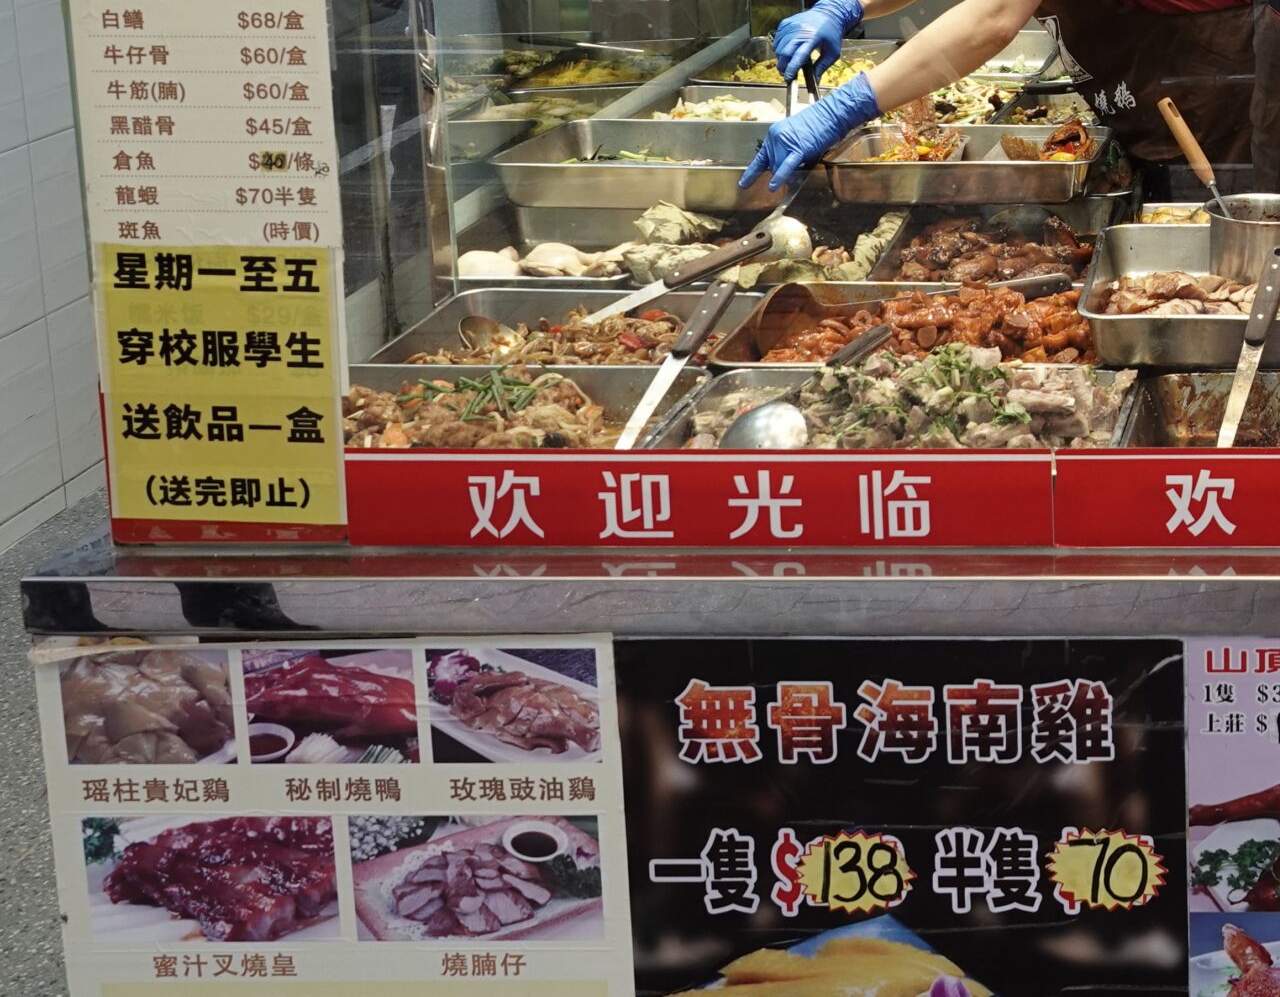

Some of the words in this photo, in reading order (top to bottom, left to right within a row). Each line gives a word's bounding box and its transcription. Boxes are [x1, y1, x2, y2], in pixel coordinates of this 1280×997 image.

[237, 10, 305, 31] $68/盒
[103, 45, 170, 66] 牛仔骨
[240, 45, 307, 66] $60/盒
[107, 80, 186, 103] 牛筋(腩)
[243, 81, 310, 101] $60/盒
[110, 115, 175, 136] 黑醋骨
[246, 116, 312, 137] $45/盒
[112, 150, 156, 171] 倉魚
[115, 185, 159, 205] 龍蝦
[235, 186, 317, 206] $70半隻
[118, 220, 161, 240] 斑魚
[263, 221, 320, 242] (時價)
[113, 251, 320, 293] 星期一至五
[117, 328, 324, 369] 穿校服學生
[122, 403, 325, 444] 送飲品一盒
[146, 475, 310, 509] (送完即止)
[467, 468, 933, 540] 欢迎光临
[1203, 683, 1235, 704] 1隻
[675, 677, 1116, 765] 無骨海南雞
[1202, 713, 1245, 734] 上莊
[285, 776, 402, 803] 秘制燒鴨
[649, 826, 760, 914] 一隻
[932, 826, 1043, 914] 半隻
[152, 953, 299, 979] 蜜汁叉燒皇
[441, 952, 529, 977] 燒腩仔
